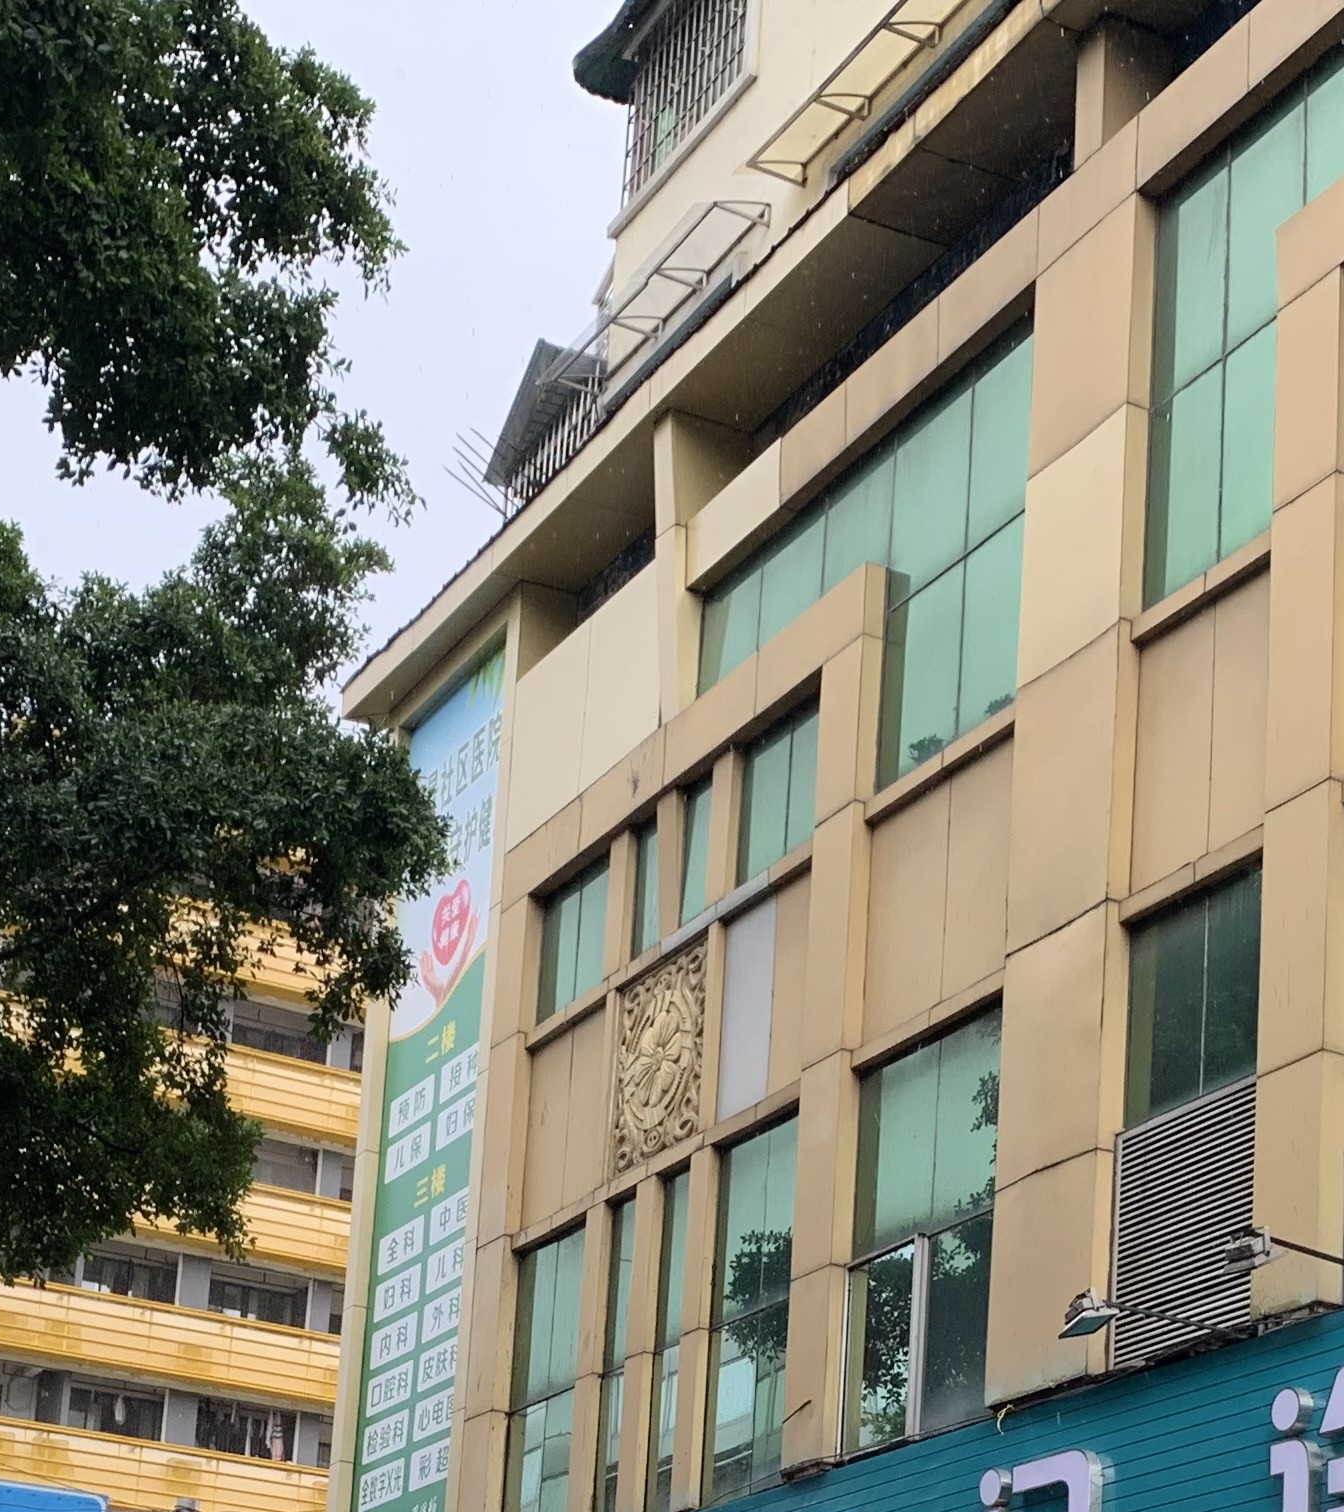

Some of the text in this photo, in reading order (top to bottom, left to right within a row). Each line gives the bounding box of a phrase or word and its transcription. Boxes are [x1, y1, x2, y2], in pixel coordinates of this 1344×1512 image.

[425, 1021, 456, 1064] 二楼
[449, 1050, 478, 1091] 接种
[397, 1087, 426, 1126] 预防
[445, 1100, 475, 1138] 妇保
[393, 1133, 422, 1172] 儿保
[413, 1163, 447, 1208] 三楼
[439, 1195, 468, 1233] 中医
[386, 1226, 415, 1265] 全科
[435, 1244, 464, 1283] 儿科
[383, 1274, 412, 1312] 妇科
[431, 1293, 460, 1334] 外科
[379, 1322, 409, 1360] 内科
[370, 1368, 410, 1409] 口腔科
[366, 1418, 406, 1458] 检验科
[418, 1448, 449, 1481] 彩超
[360, 1465, 403, 1507] 全数字X光
